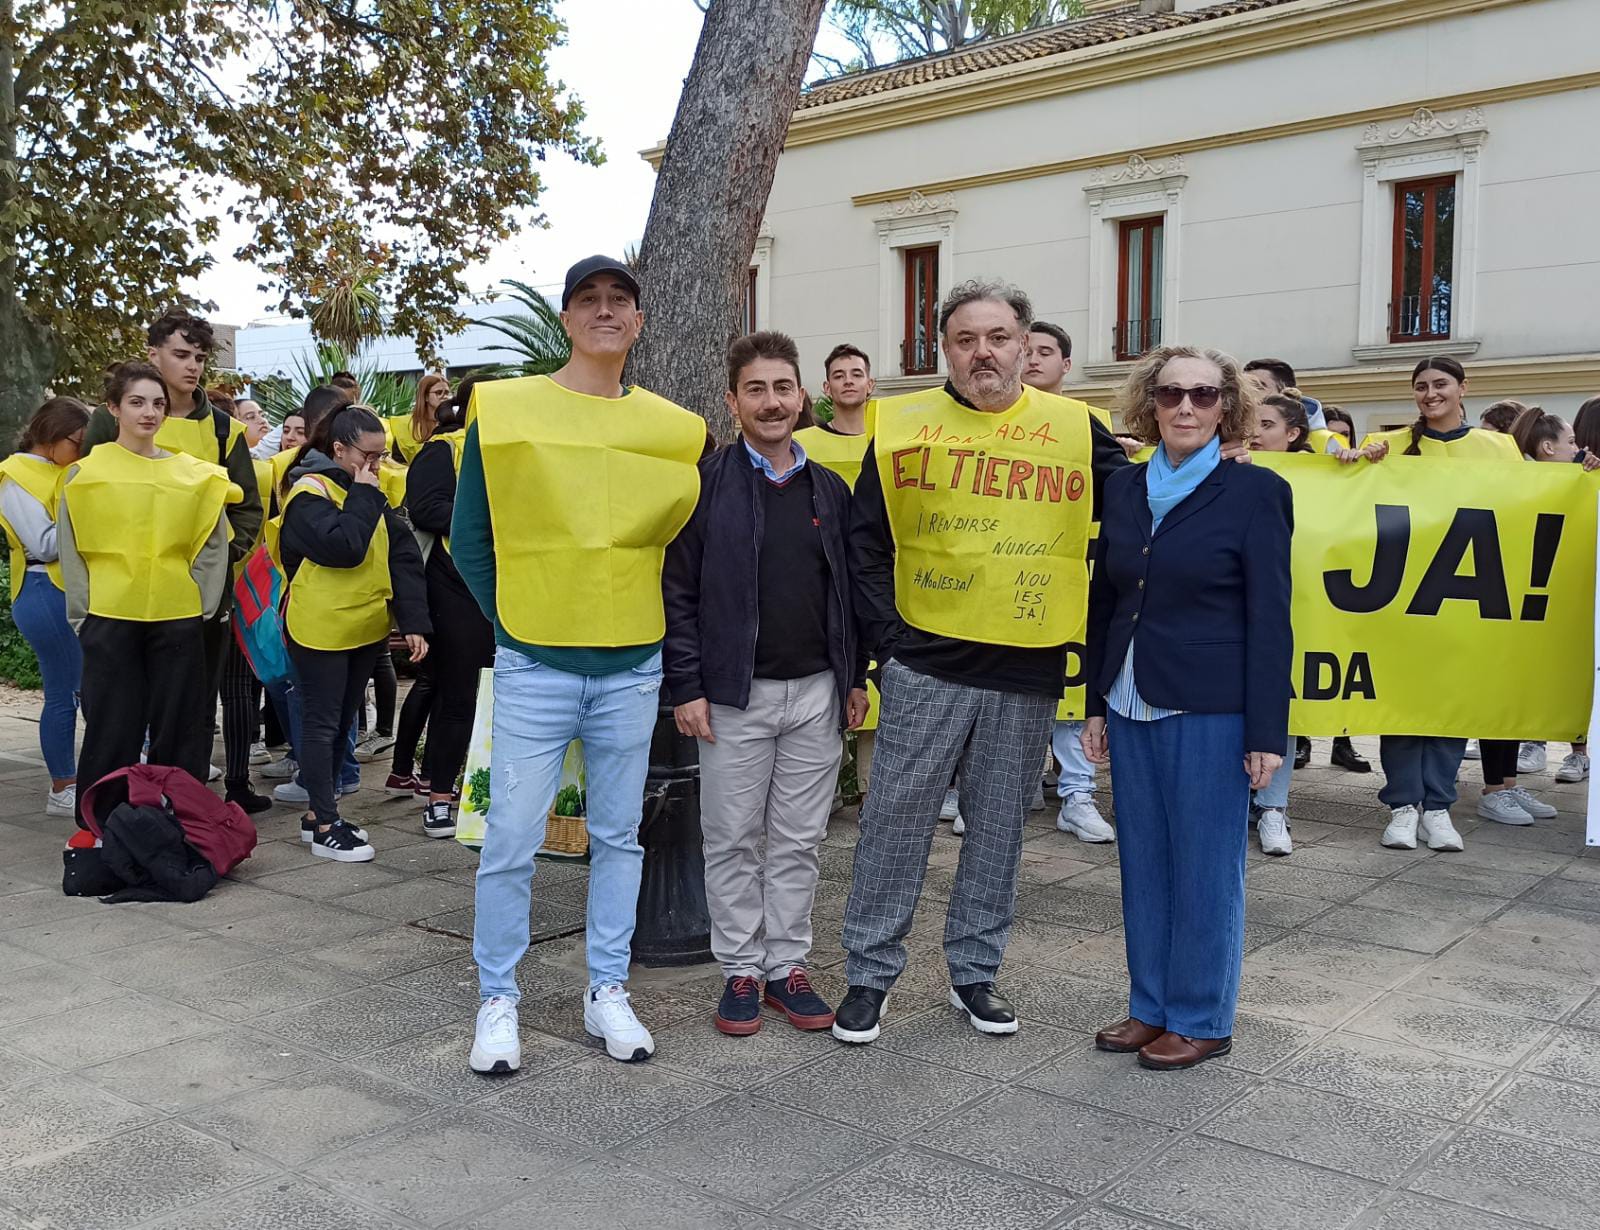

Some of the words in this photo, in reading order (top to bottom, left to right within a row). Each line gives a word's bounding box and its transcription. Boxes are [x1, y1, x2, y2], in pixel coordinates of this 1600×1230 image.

[891, 446, 936, 490] EL
[992, 531, 1064, 556] NUNCA!
[1323, 504, 1565, 621] JA!
[1014, 571, 1051, 586] NOU
[1014, 590, 1043, 604] IES
[1013, 606, 1046, 625] JA!
[1290, 651, 1376, 700] DA
